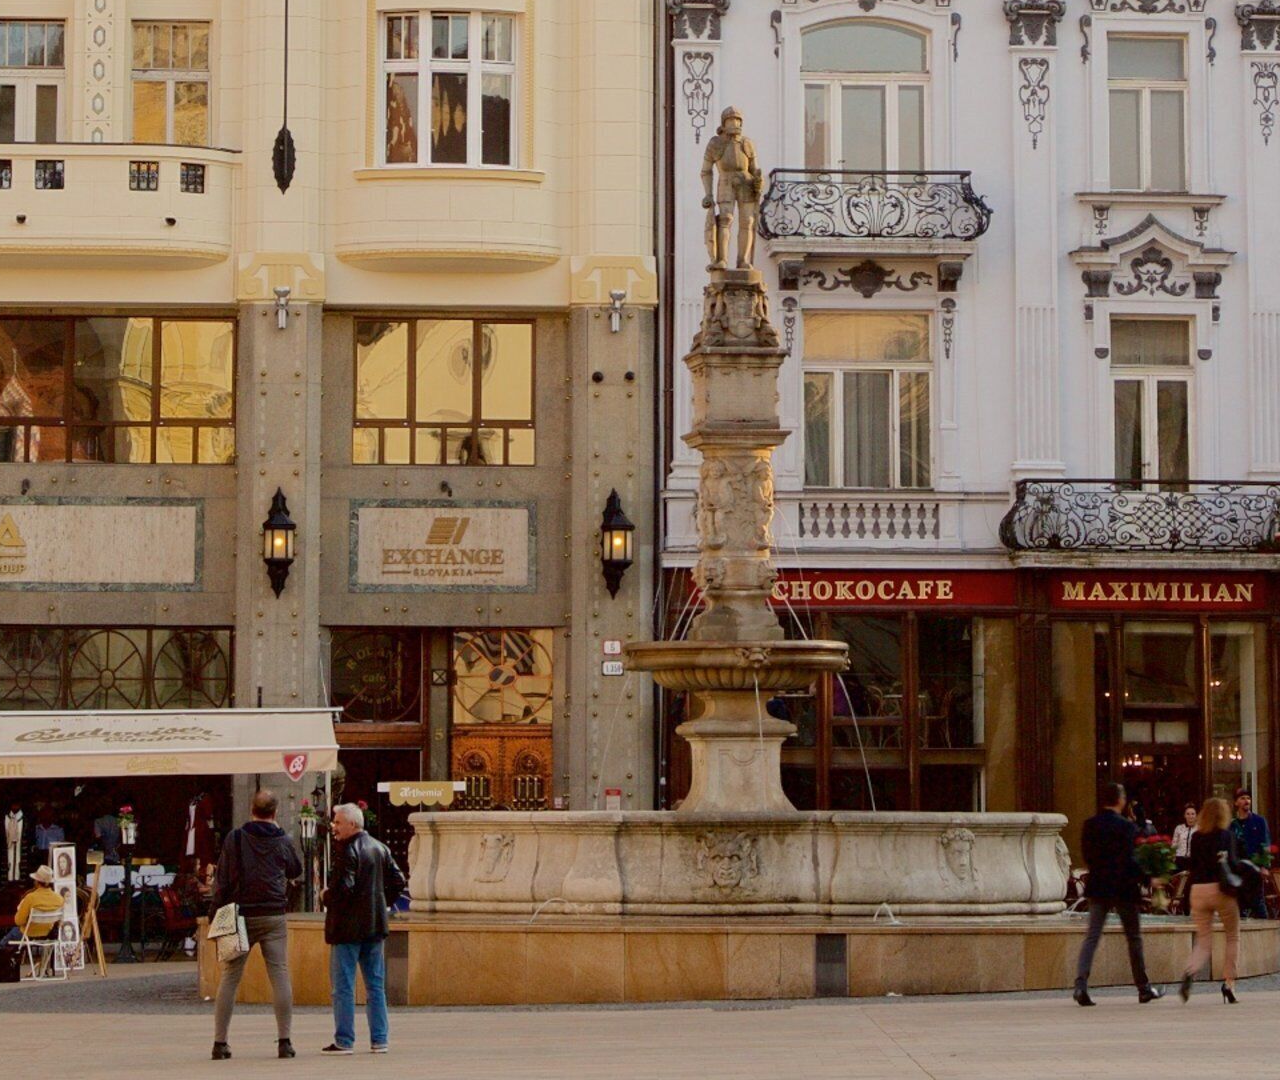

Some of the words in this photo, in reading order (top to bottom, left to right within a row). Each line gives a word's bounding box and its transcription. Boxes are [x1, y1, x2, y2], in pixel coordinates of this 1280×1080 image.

[382, 548, 505, 565] EXCHANGE
[413, 569, 474, 577] SLOVAKIA
[771, 580, 954, 601] CHOKOCAFE
[1061, 581, 1254, 603] MAXIMILIAN
[435, 728, 443, 740] 5
